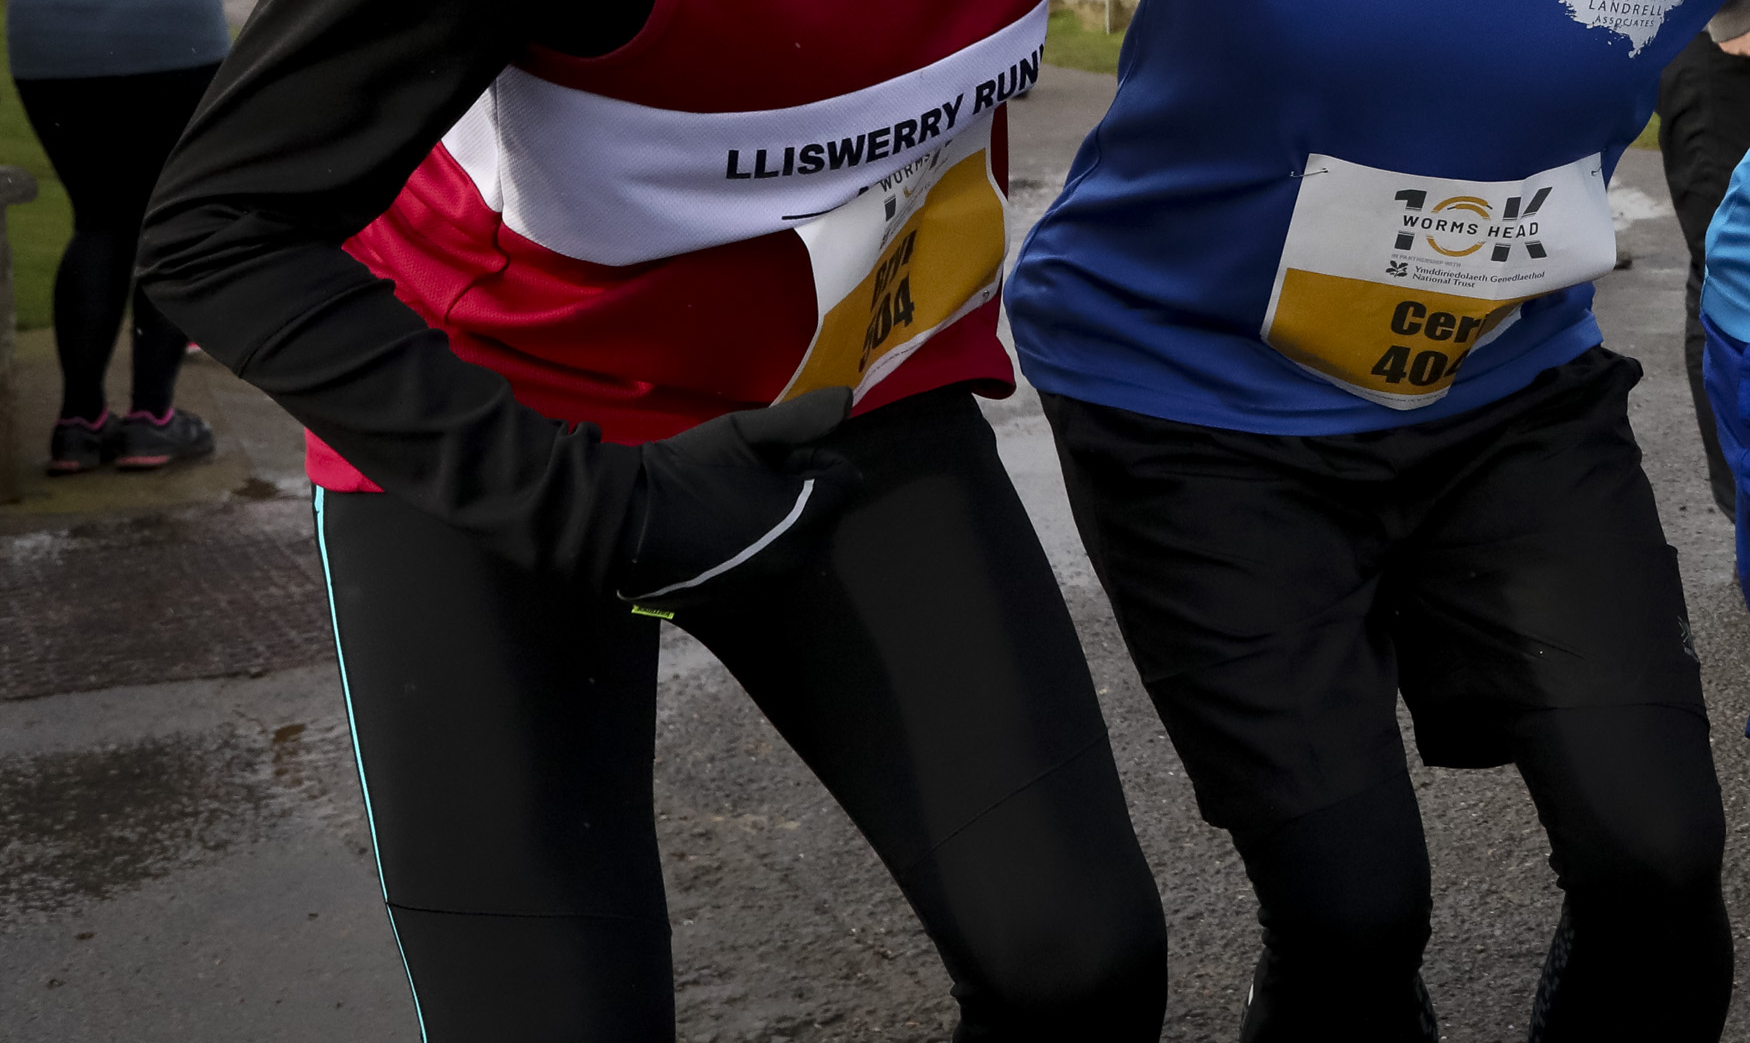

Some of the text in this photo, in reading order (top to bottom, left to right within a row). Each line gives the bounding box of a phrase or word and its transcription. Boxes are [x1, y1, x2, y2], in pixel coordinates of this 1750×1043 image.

[1588, 0, 1662, 16] LANDRELL
[1595, 16, 1656, 28] ASSOCIATES
[726, 93, 964, 179] LLISWERRY
[1394, 186, 1553, 263] 10K
[1403, 215, 1539, 239] WORMS HEAD
[1412, 273, 1476, 288] National Trust
[1490, 271, 1545, 283] Genedlaethol
[1390, 301, 1489, 343] Cer
